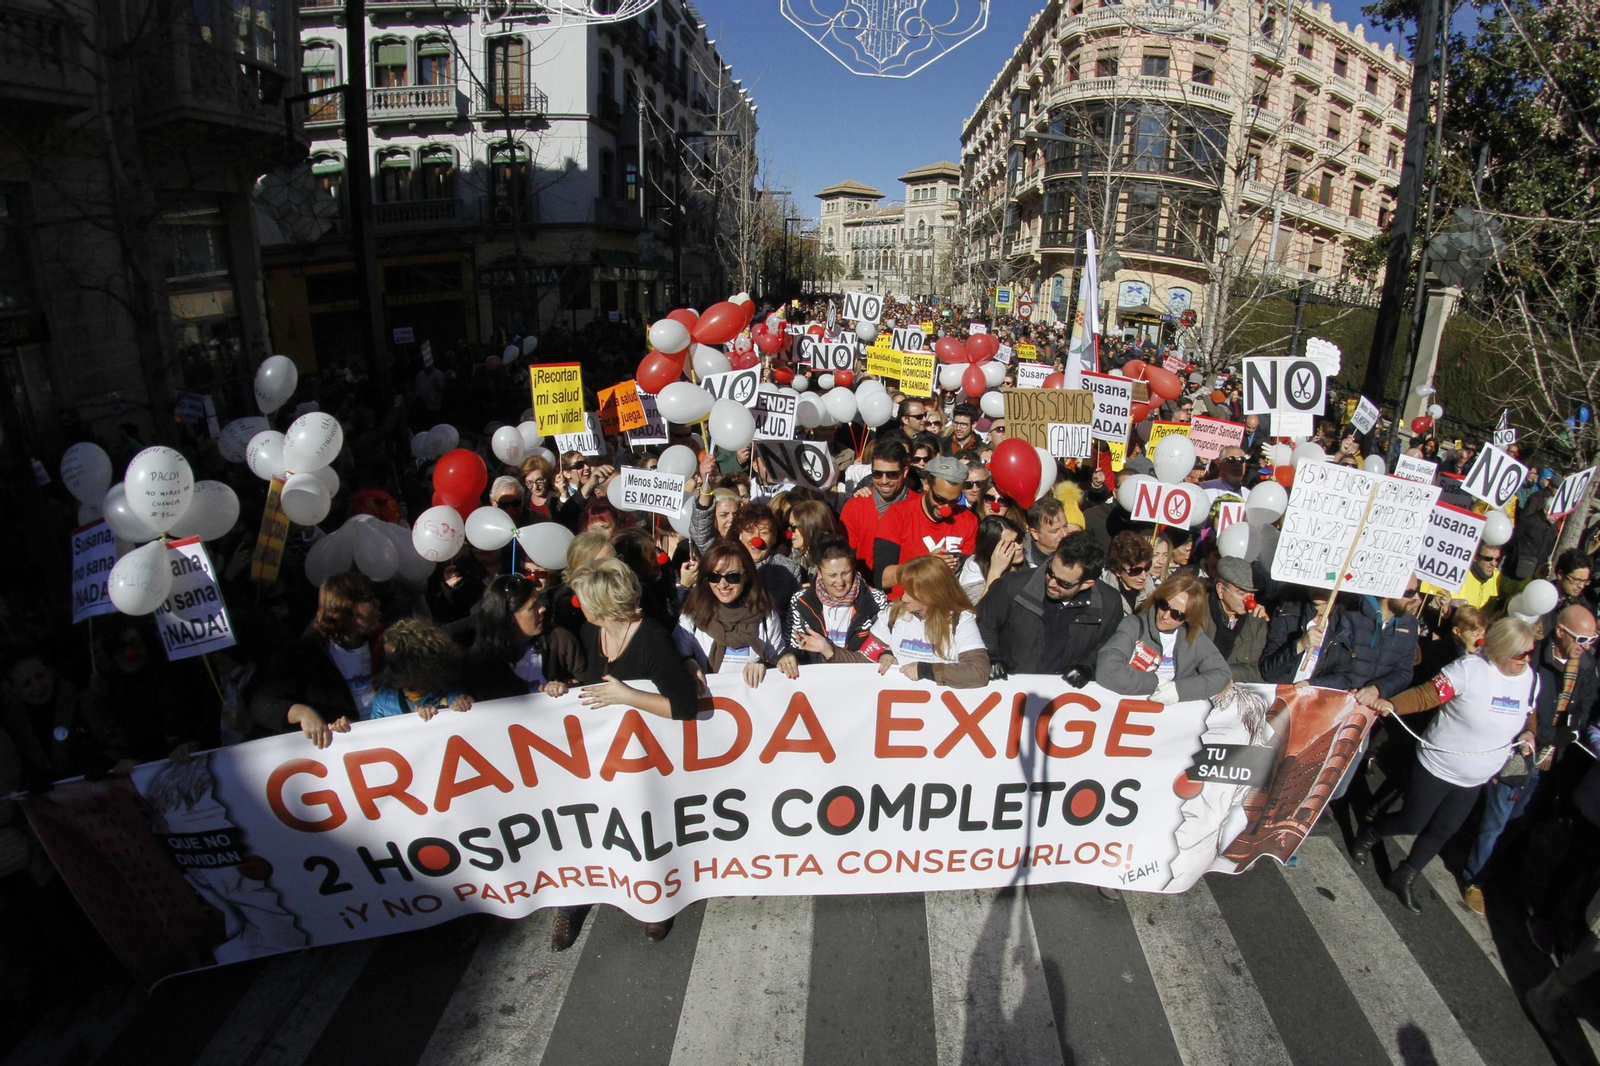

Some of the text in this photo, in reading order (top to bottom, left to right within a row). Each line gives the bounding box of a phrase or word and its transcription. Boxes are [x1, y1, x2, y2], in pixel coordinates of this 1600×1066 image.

[844, 293, 880, 321] NO
[892, 329, 923, 351] NO
[812, 345, 852, 370] NO
[902, 356, 932, 368] RECORTES
[534, 368, 578, 388] ¡Recortan
[901, 380, 908, 388] EN
[902, 368, 931, 380] HOMICIDAS
[1246, 361, 1323, 411] NO
[536, 388, 580, 406] mi salud
[620, 390, 638, 405] salud
[702, 371, 757, 402] NO
[1082, 378, 1130, 400] Susana,
[759, 394, 795, 413] ENDE
[1004, 391, 1094, 424] TODOS SOMOS
[1099, 404, 1128, 418] sana
[539, 408, 582, 430] y mi vida!
[756, 414, 788, 438] ALUD.
[1094, 420, 1127, 436] ADA!
[1194, 421, 1218, 436] Recortar
[1050, 425, 1091, 458] CANDEL
[1495, 430, 1514, 444] NO
[757, 442, 830, 489] NO
[1466, 447, 1522, 507] NO
[624, 474, 683, 492] ¡Menos Sanidad
[1298, 463, 1434, 508] 15 DE ENERO GRANADA
[1550, 472, 1590, 515] NO
[624, 490, 682, 511] ES MORTAL!
[1135, 483, 1191, 524] NO
[1287, 487, 1302, 508] 2
[1302, 490, 1368, 522] HOSPITALES
[1366, 503, 1419, 530] COMPLETOS
[1220, 506, 1248, 533] N
[74, 529, 115, 555] Susana,
[1359, 526, 1369, 544] A
[1280, 537, 1414, 577] HOSPITALES COMPLETOS
[1436, 538, 1472, 561] sana
[74, 555, 115, 582] no sana
[171, 554, 208, 577] ana,
[1417, 554, 1466, 584] NADA!
[74, 584, 109, 612] ¡NADA
[156, 584, 218, 614] no sana
[164, 612, 228, 652] ¡NADA!
[266, 688, 1164, 833] GRANADA EXIGE
[1206, 747, 1227, 761] TU
[1197, 763, 1253, 782] SALUD
[168, 834, 231, 850] QUE NO
[303, 778, 1141, 895] 2 HOSPITALES COMPLETOS
[175, 850, 242, 866] DIVIDAN
[1117, 859, 1161, 887] YEAH!
[337, 841, 1133, 931] ¡Y NO PARAREMOS HASTA CONSEGUIRLOS!
